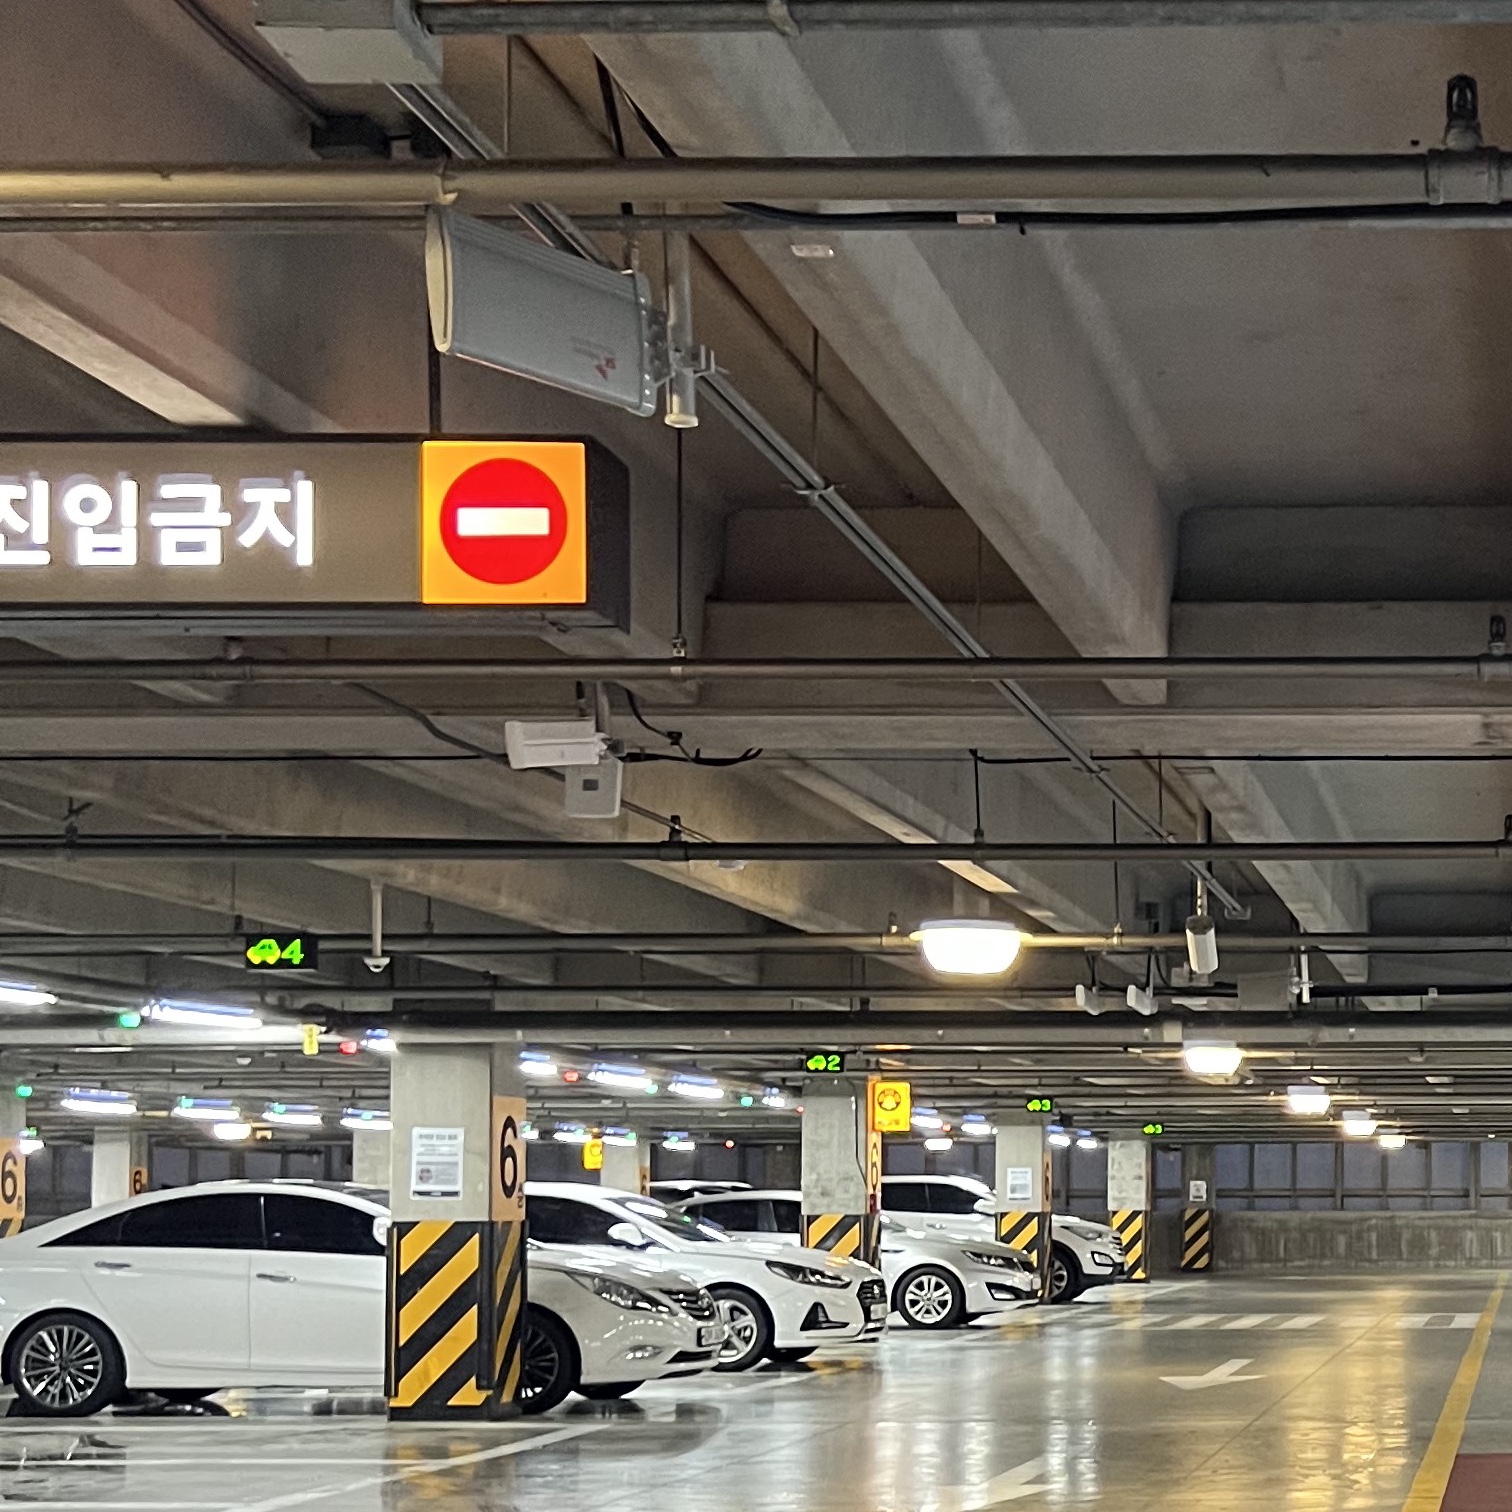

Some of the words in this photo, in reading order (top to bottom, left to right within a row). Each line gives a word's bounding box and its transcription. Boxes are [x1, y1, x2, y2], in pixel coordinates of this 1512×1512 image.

[0, 478, 315, 567] 진입금지
[281, 938, 305, 965] 4
[827, 1054, 841, 1071] 2
